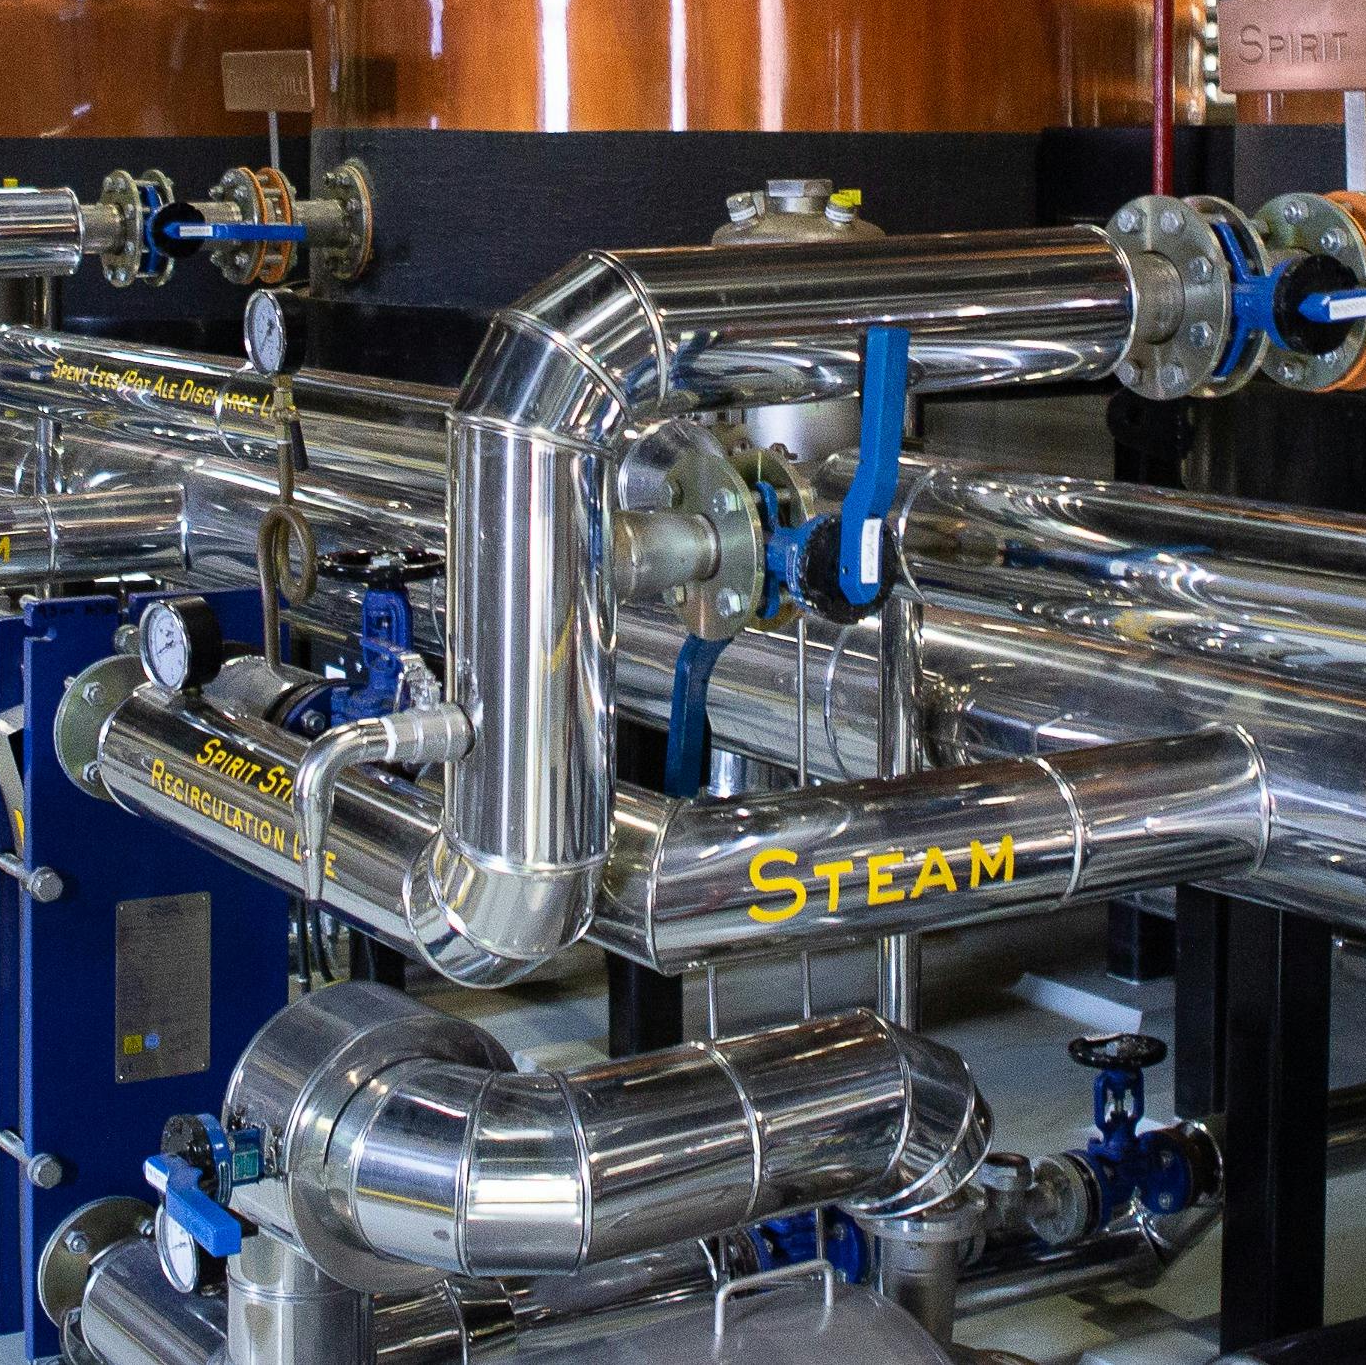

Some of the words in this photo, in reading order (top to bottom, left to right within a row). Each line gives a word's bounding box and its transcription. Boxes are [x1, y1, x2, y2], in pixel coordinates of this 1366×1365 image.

[1239, 24, 1348, 65] SPIRIT
[196, 738, 262, 784] SPIRIT
[151, 758, 285, 854] RECIRCULATION
[293, 832, 338, 880] LE
[747, 834, 1016, 923] STEAM
